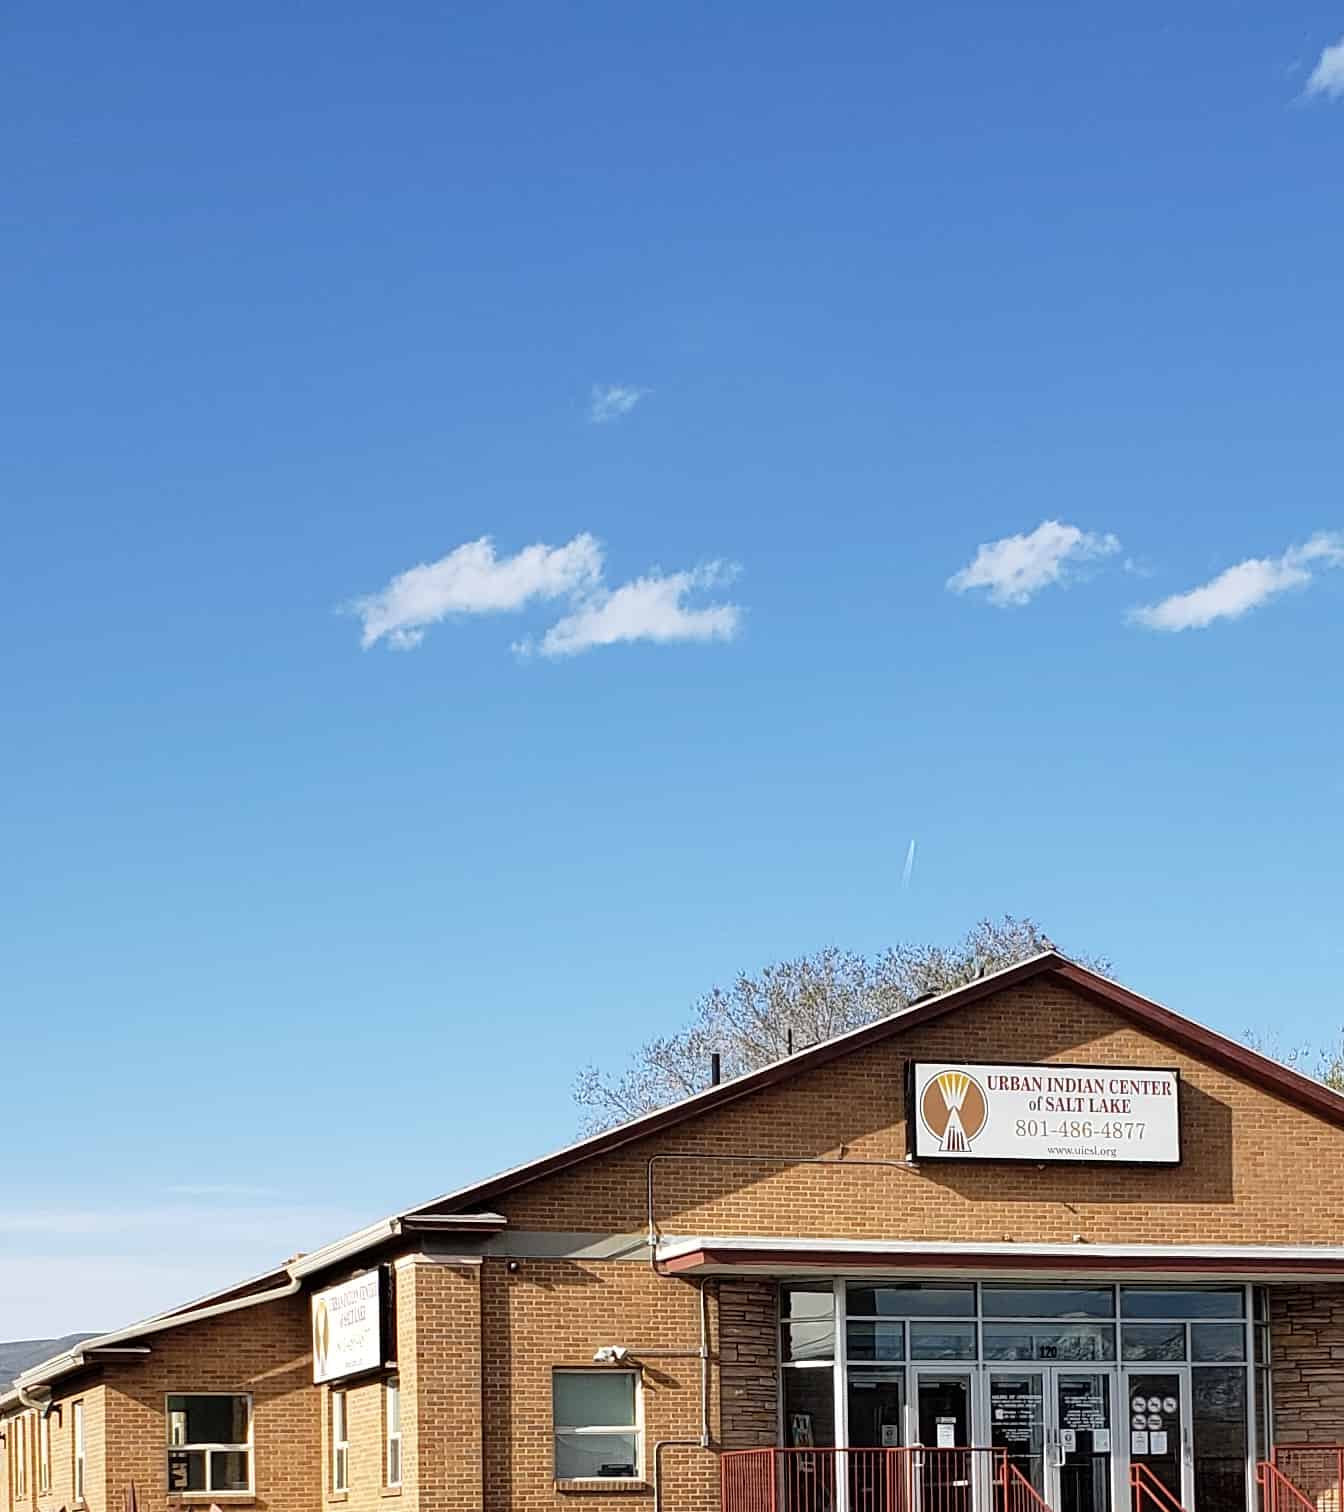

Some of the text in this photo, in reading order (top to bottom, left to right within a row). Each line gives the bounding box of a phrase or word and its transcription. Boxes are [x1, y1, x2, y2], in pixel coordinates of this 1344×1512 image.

[986, 1075, 1172, 1096] URBAN INDIAN CENTER
[1028, 1096, 1132, 1113] of SALT LAKE
[1015, 1119, 1146, 1139] 801-486-4877
[1040, 1345, 1057, 1358] 120
